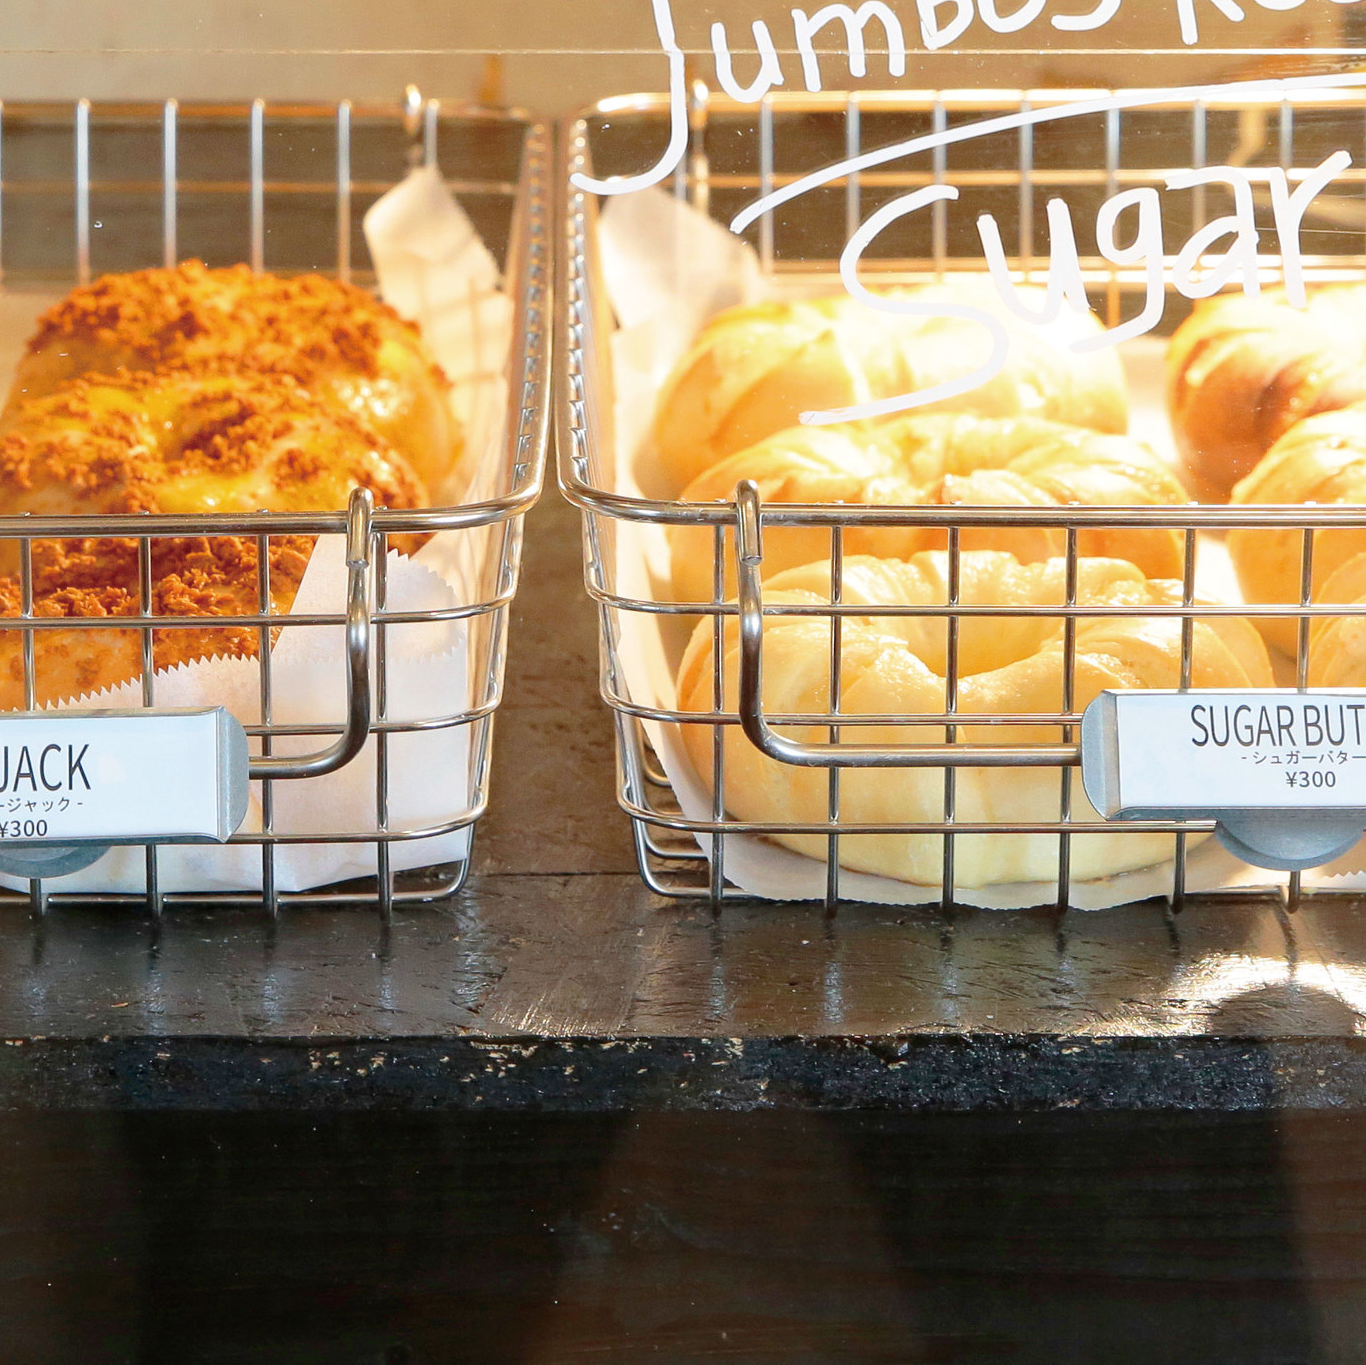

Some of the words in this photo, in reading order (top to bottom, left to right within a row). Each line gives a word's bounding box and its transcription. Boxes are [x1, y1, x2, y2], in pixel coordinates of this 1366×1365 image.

[797, 150, 1353, 426] Sugar
[1190, 703, 1296, 748] SUGAR
[1285, 770, 1337, 789] ¥300
